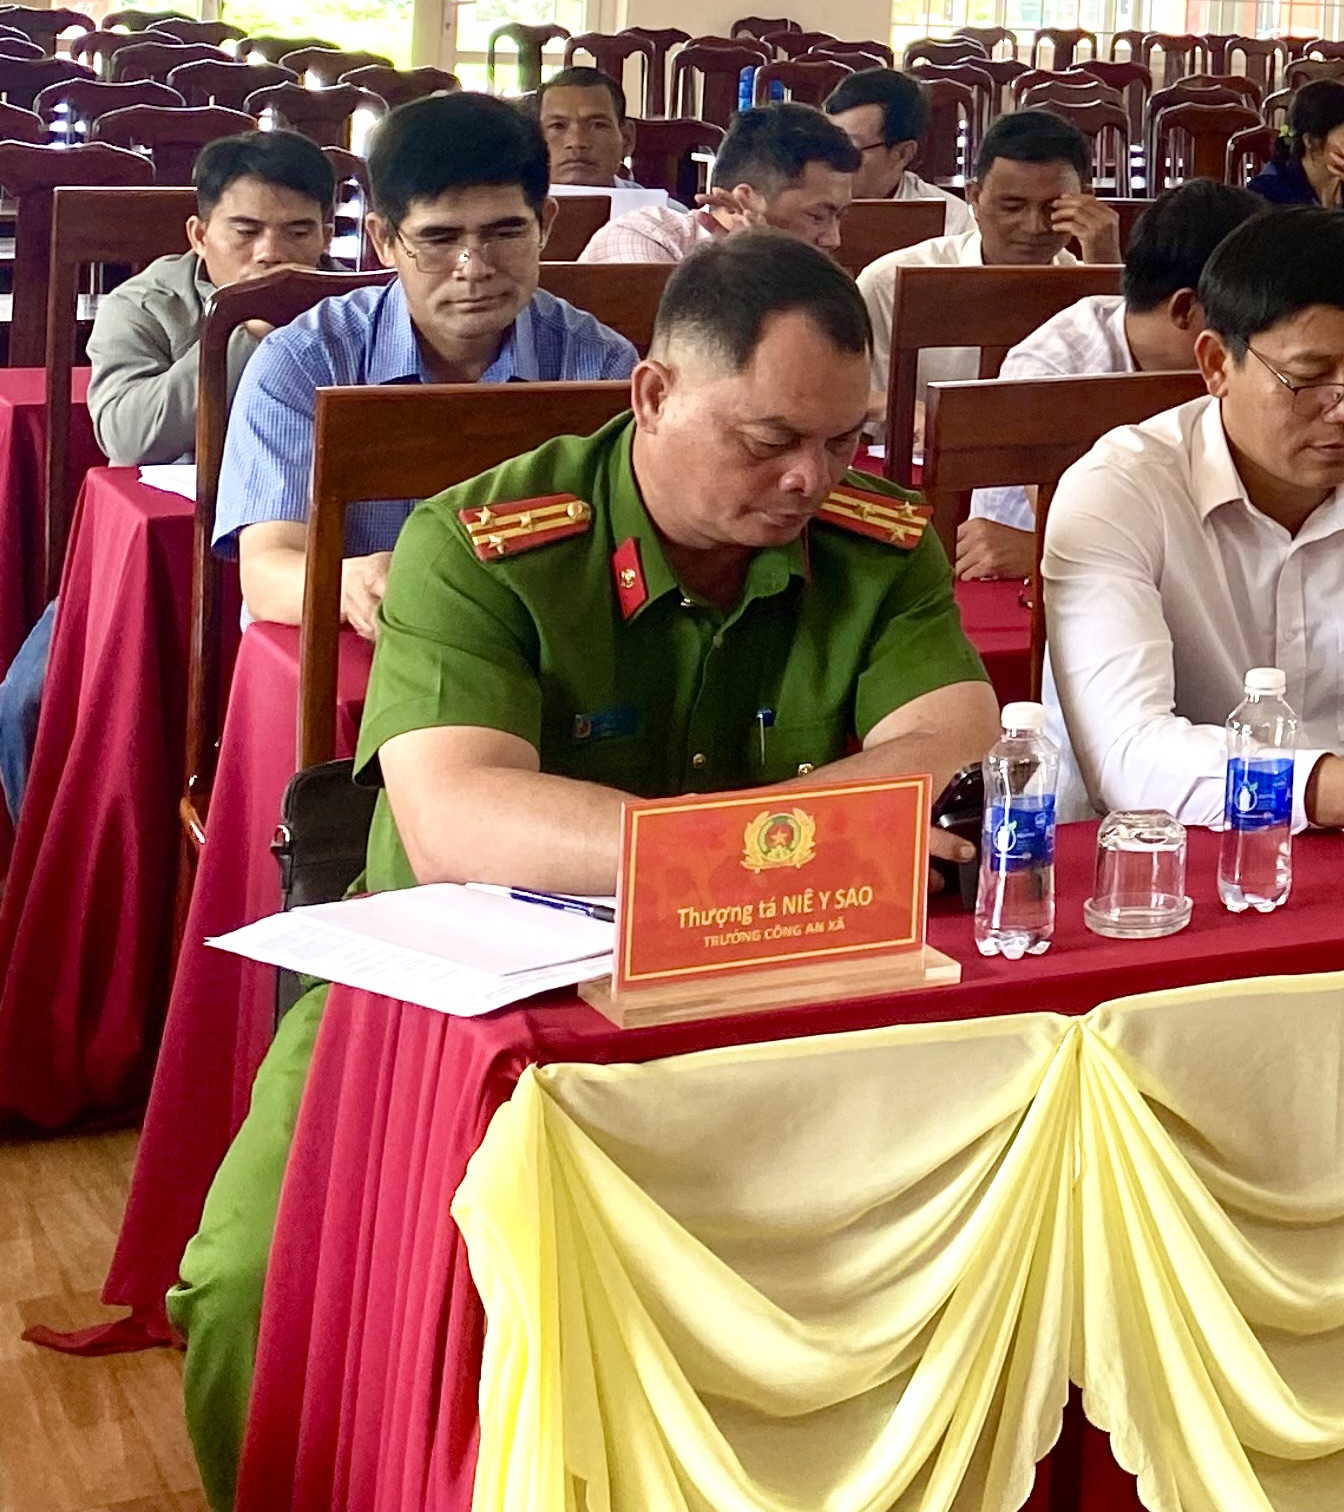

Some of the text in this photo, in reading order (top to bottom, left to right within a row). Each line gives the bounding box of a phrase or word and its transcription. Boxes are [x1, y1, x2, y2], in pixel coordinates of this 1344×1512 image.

[677, 904, 753, 929] Thượng
[759, 896, 776, 918] tá
[782, 887, 814, 916] NIÊ
[818, 890, 832, 910] Y
[763, 923, 802, 941] CÔNG
[805, 920, 825, 936] AN
[827, 915, 846, 932] XÃ
